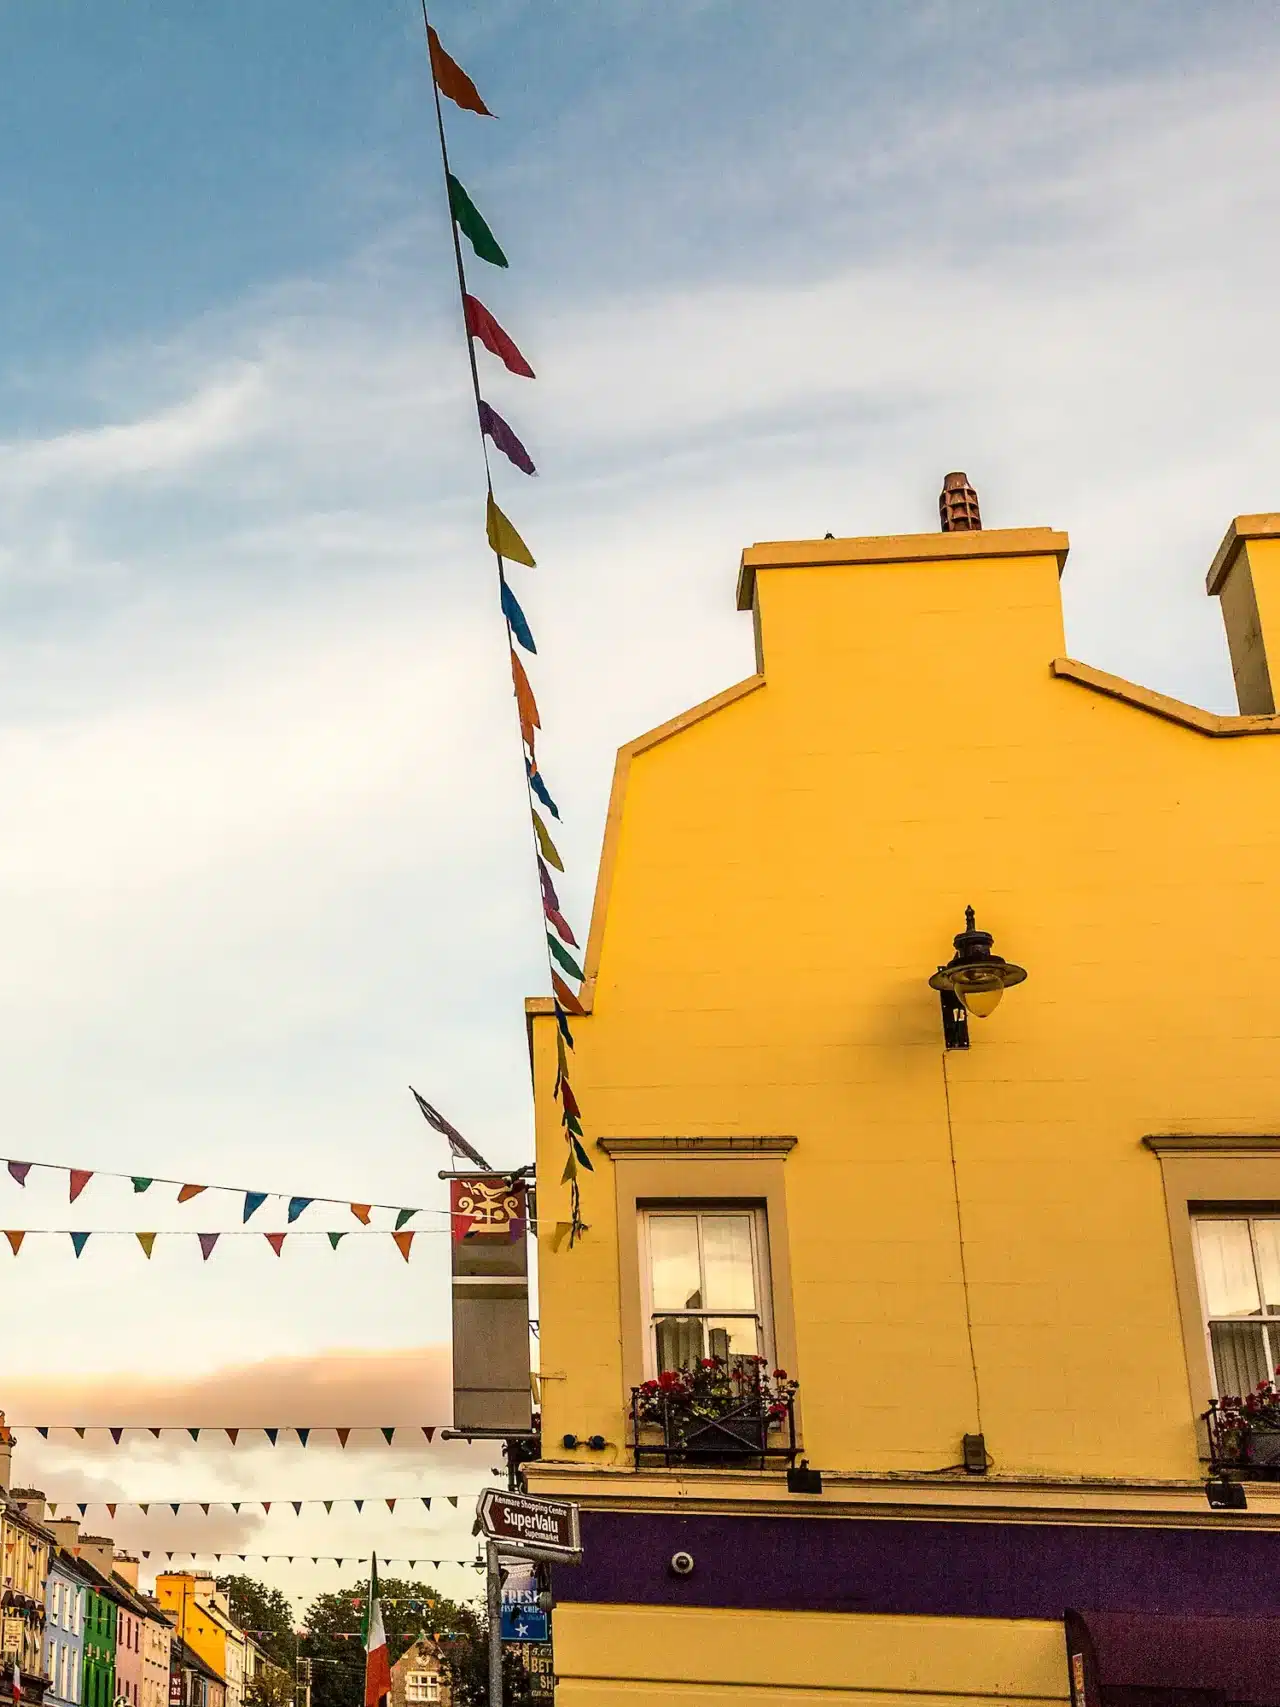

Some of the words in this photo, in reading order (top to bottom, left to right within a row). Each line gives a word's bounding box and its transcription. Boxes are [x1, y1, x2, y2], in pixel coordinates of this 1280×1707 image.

[494, 1495, 520, 1507] Kenmare
[521, 1500, 548, 1514] Shopping
[548, 1505, 567, 1516] Centre
[503, 1507, 558, 1533] SuperValu
[524, 1529, 560, 1543] Supermarket
